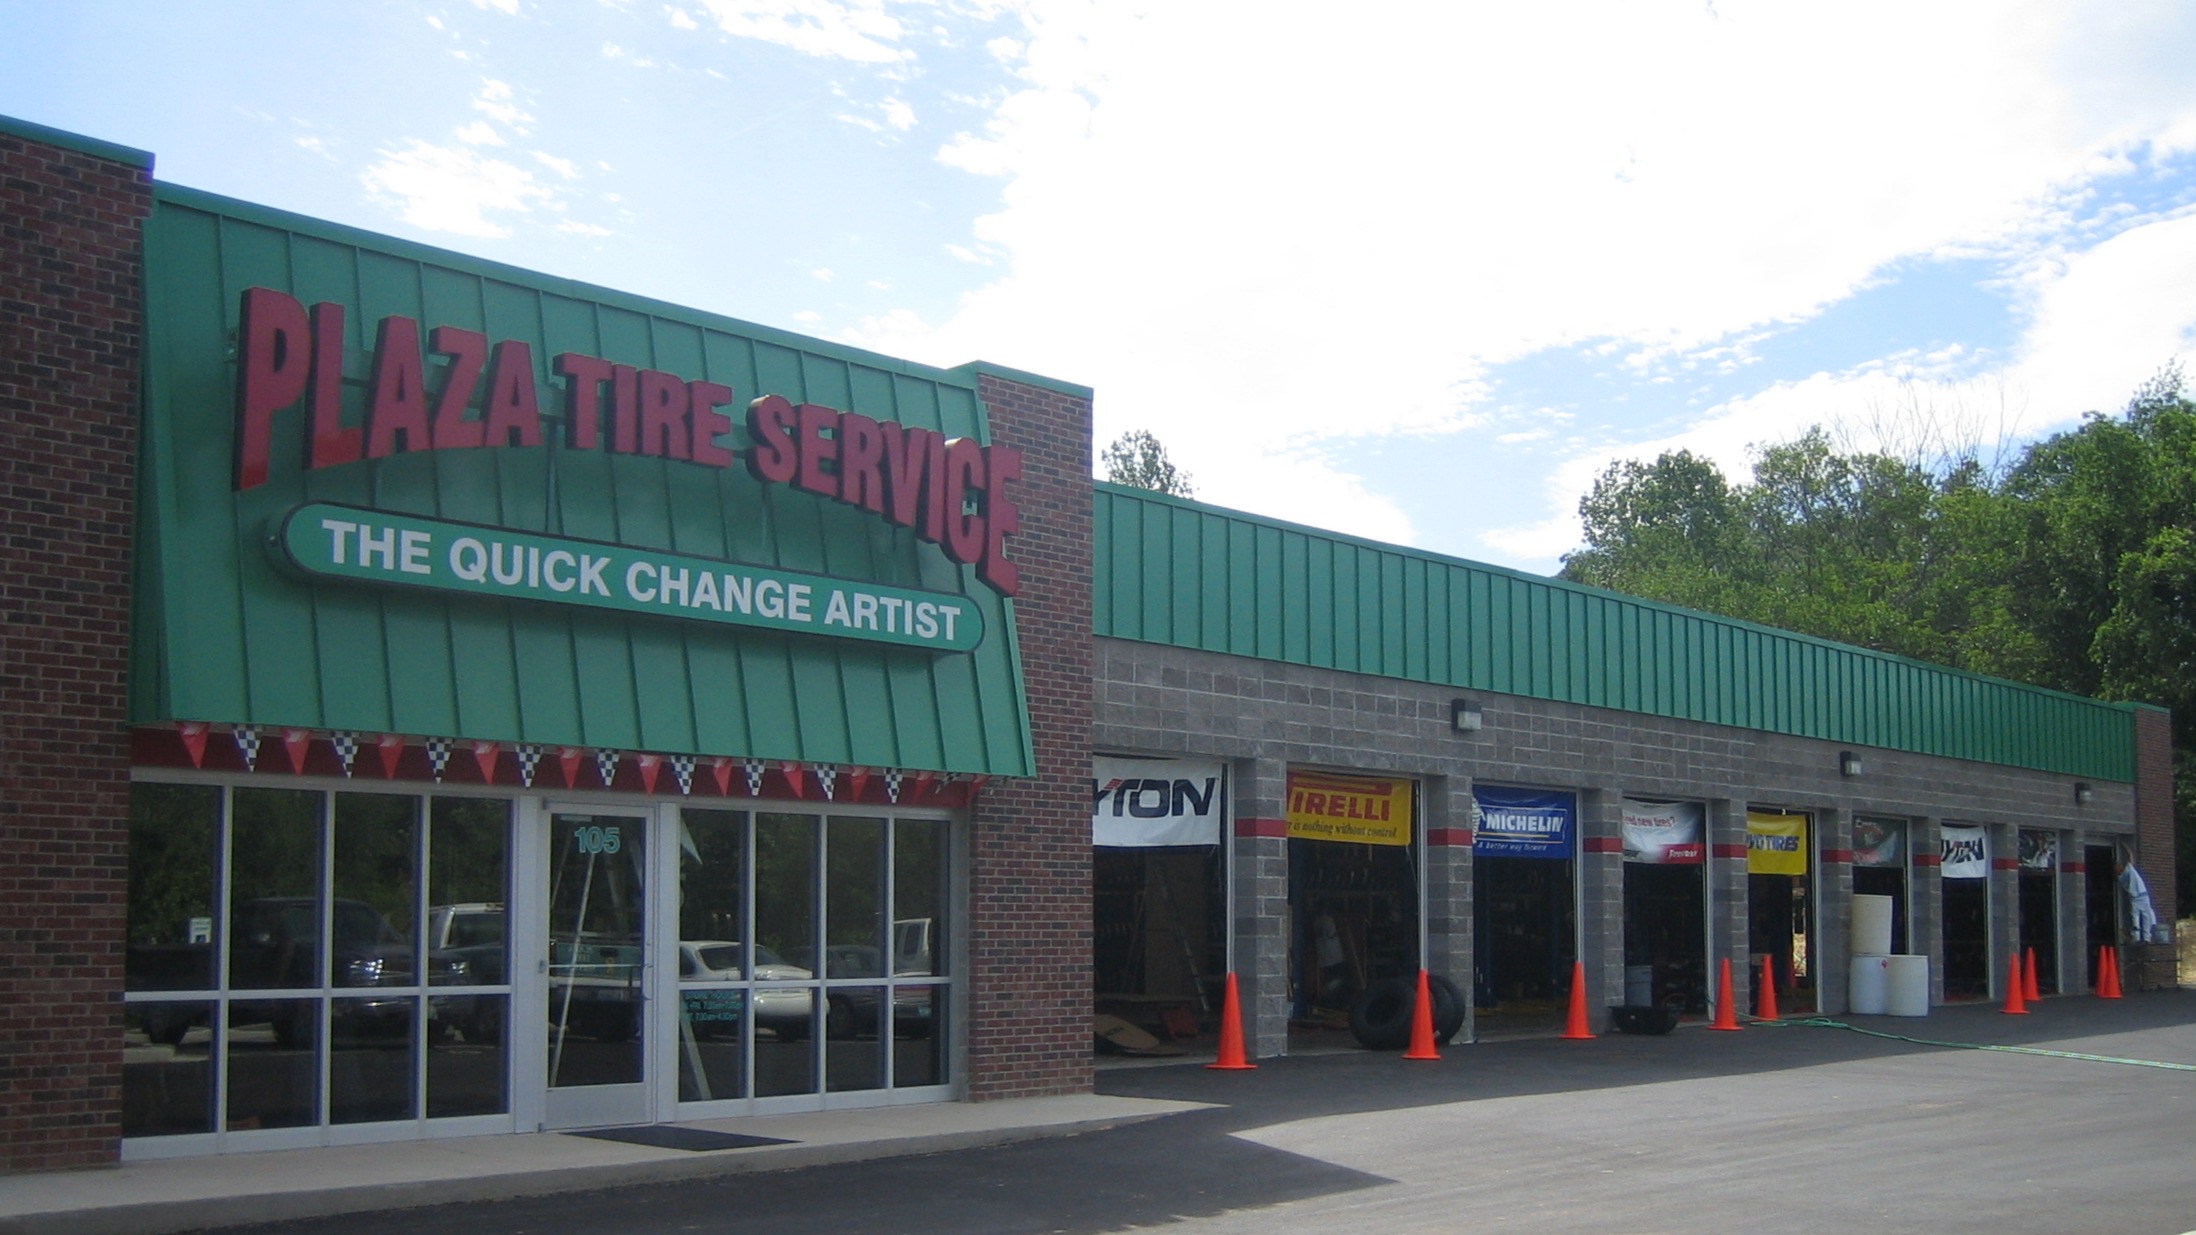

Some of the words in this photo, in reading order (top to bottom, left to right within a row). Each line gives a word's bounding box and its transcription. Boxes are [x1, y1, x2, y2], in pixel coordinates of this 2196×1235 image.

[232, 287, 543, 491] PLAZA
[553, 352, 733, 468] TIRE
[745, 395, 1022, 598] SERVICE
[322, 519, 431, 574] THE
[450, 537, 611, 597] QUICK
[626, 561, 812, 622] CHANGE
[824, 590, 961, 641] ARTIST
[1302, 820, 1334, 836] nothing
[1335, 822, 1366, 836] without
[1367, 826, 1397, 837] control
[1486, 813, 1564, 832] MICHELIN
[575, 826, 620, 854] 105
[1486, 842, 1508, 850] better
[1766, 835, 1799, 852] TIRES
